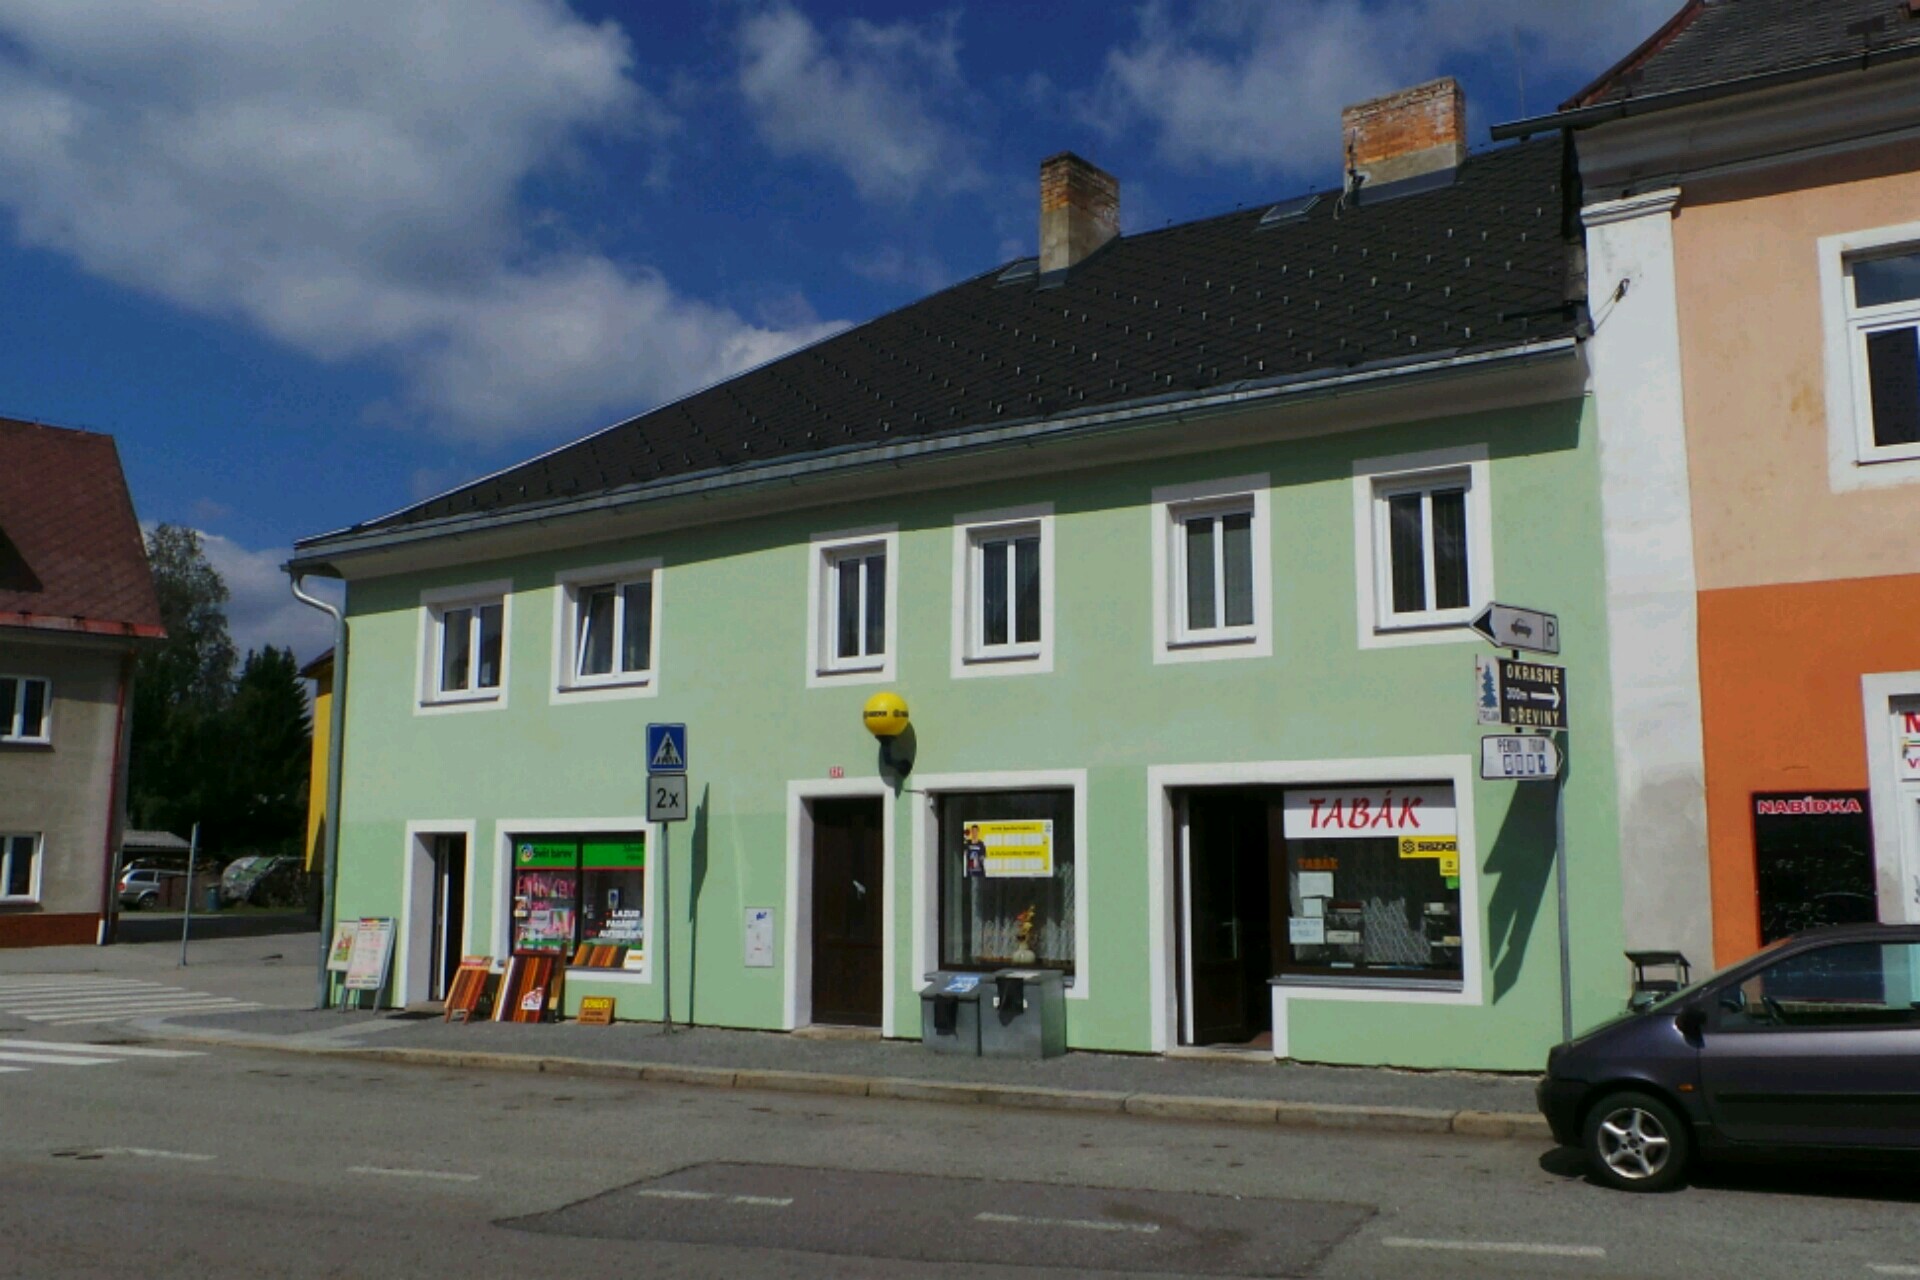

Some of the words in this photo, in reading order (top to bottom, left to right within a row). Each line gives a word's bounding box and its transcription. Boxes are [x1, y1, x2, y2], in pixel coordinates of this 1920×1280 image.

[1546, 622, 1555, 646] P
[1506, 663, 1560, 685] OKRASNÉ
[1509, 705, 1560, 726] DŘEVINY
[655, 787, 680, 809] 2x
[1308, 789, 1424, 829] TABÁK
[1757, 796, 1863, 814] NABÍDKA
